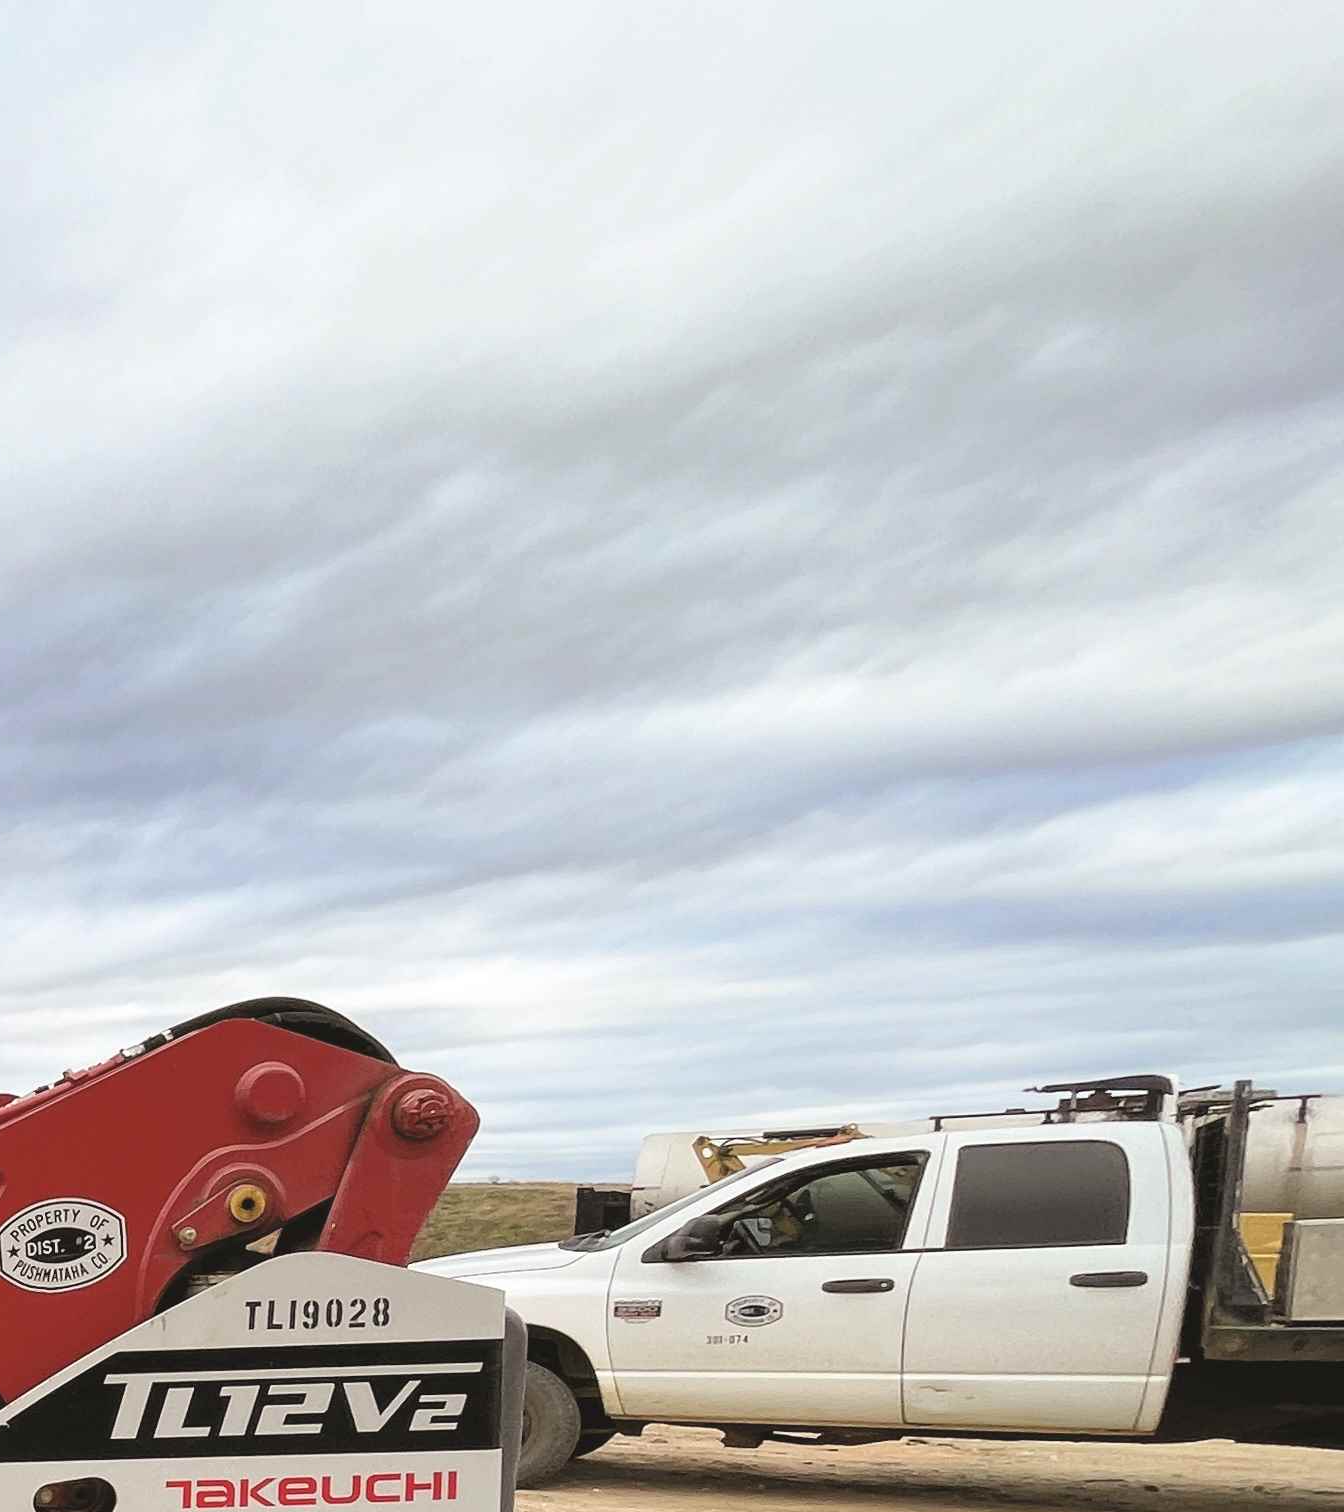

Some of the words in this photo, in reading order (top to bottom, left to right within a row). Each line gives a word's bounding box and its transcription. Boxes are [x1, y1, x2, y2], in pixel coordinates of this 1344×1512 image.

[10, 1208, 81, 1243] PROPERTY
[89, 1214, 110, 1231] OF
[26, 1238, 66, 1257] DIST.
[12, 1259, 89, 1283] PUSHMATAHA
